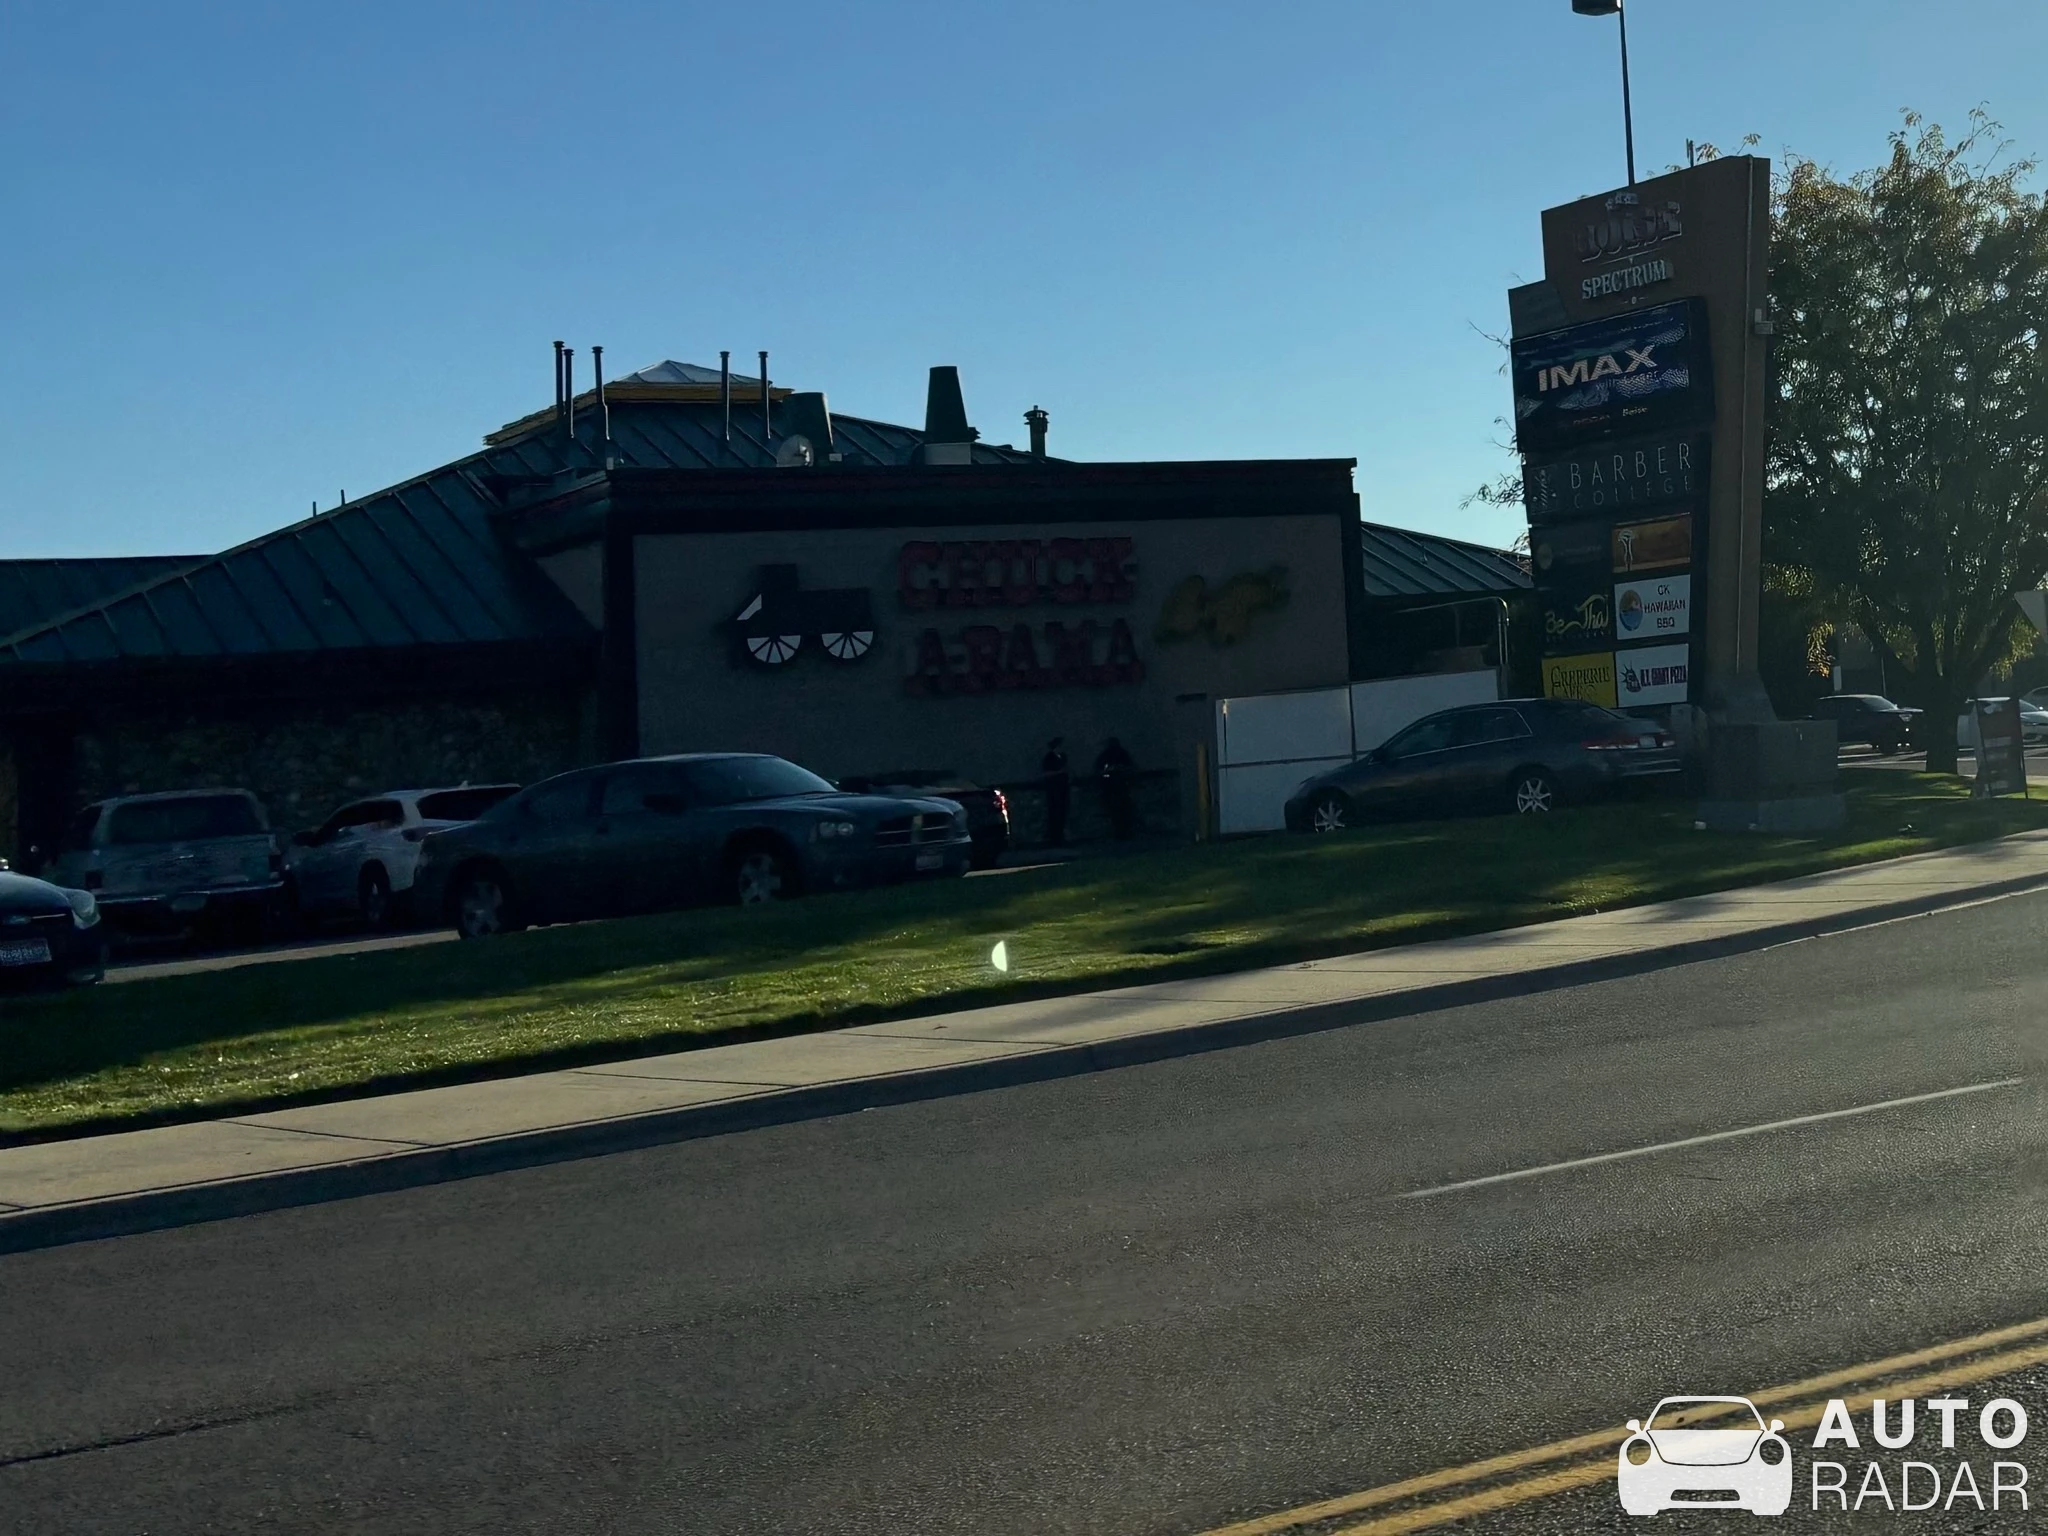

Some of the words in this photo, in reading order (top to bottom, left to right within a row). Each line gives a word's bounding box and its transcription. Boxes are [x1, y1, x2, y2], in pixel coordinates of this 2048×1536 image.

[1581, 259, 1668, 300] SPECTRUM
[1538, 344, 1658, 393] IMAX
[1569, 442, 1692, 490] BARBER
[1574, 475, 1692, 509] COLLEGE
